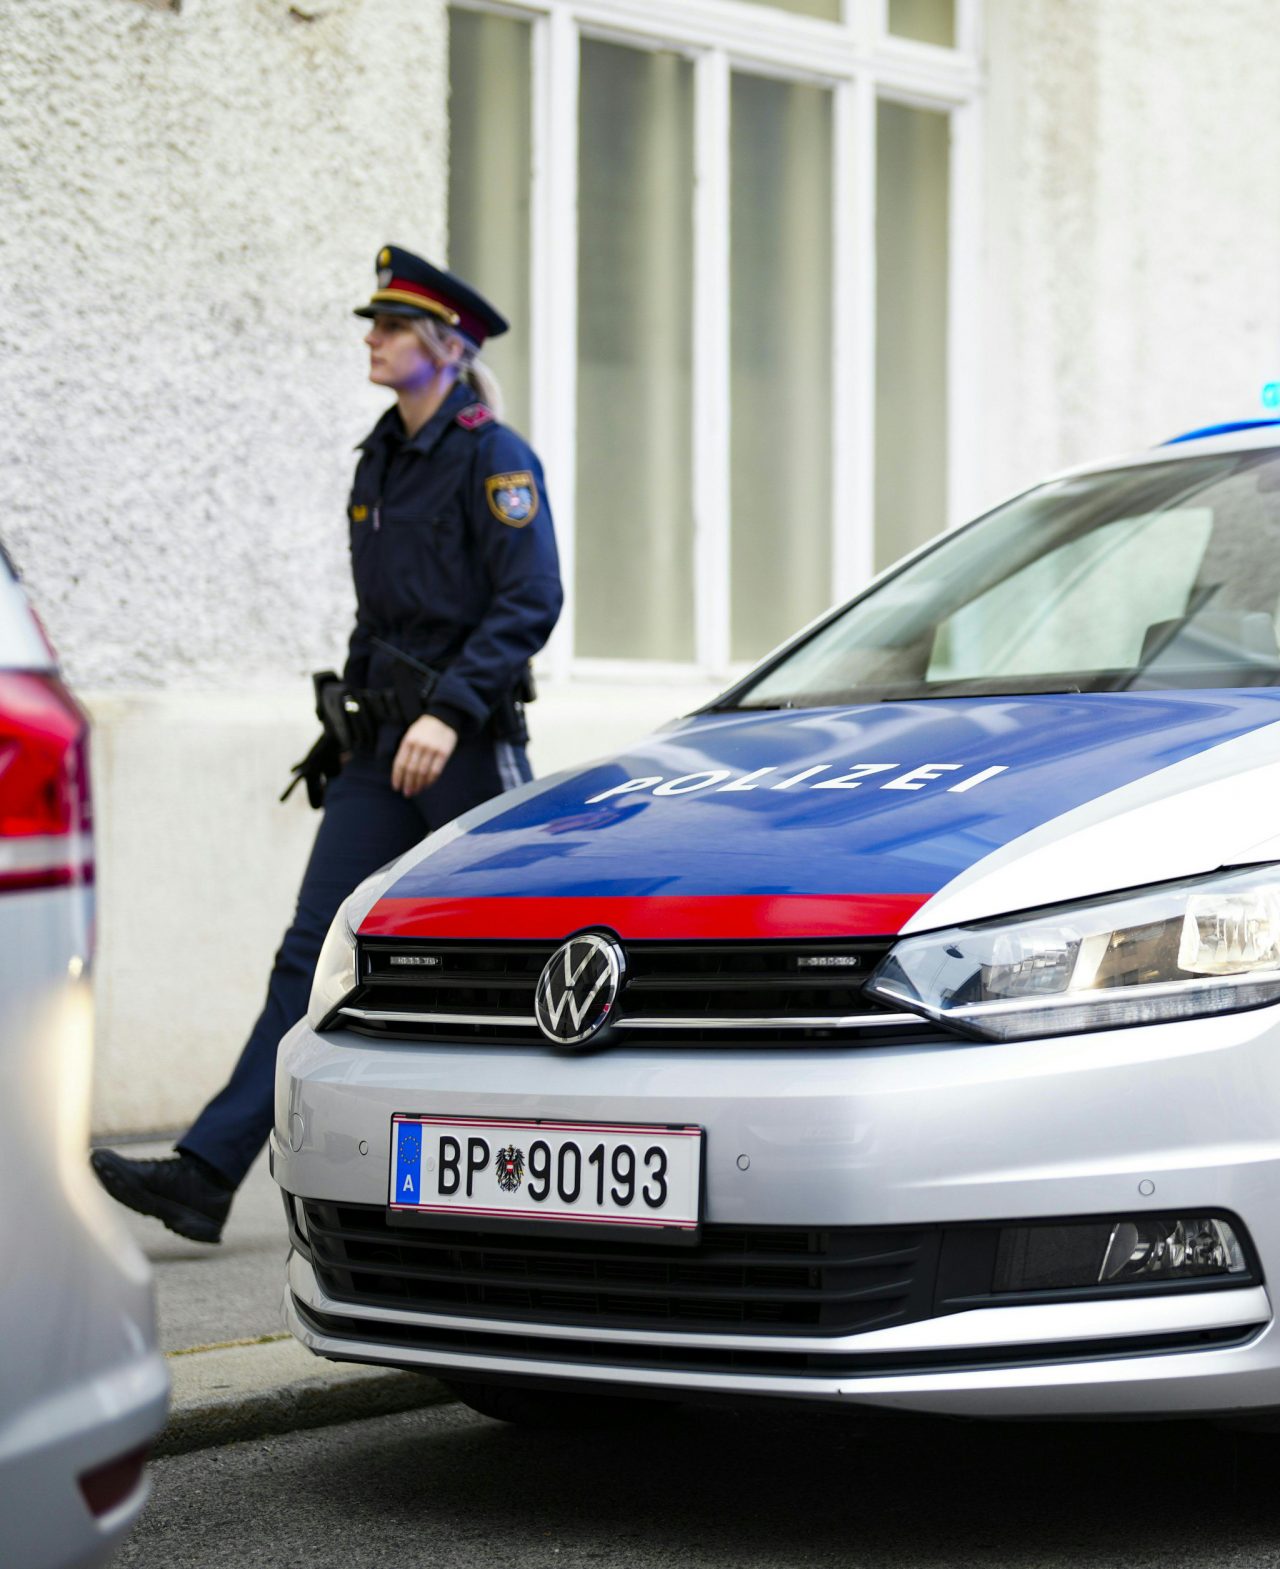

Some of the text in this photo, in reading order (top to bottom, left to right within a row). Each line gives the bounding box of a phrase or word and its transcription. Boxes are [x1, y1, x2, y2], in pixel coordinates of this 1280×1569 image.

[584, 763, 1009, 804] POLIZEI
[402, 1174, 414, 1192] A
[438, 1136, 667, 1208] BP 90193
